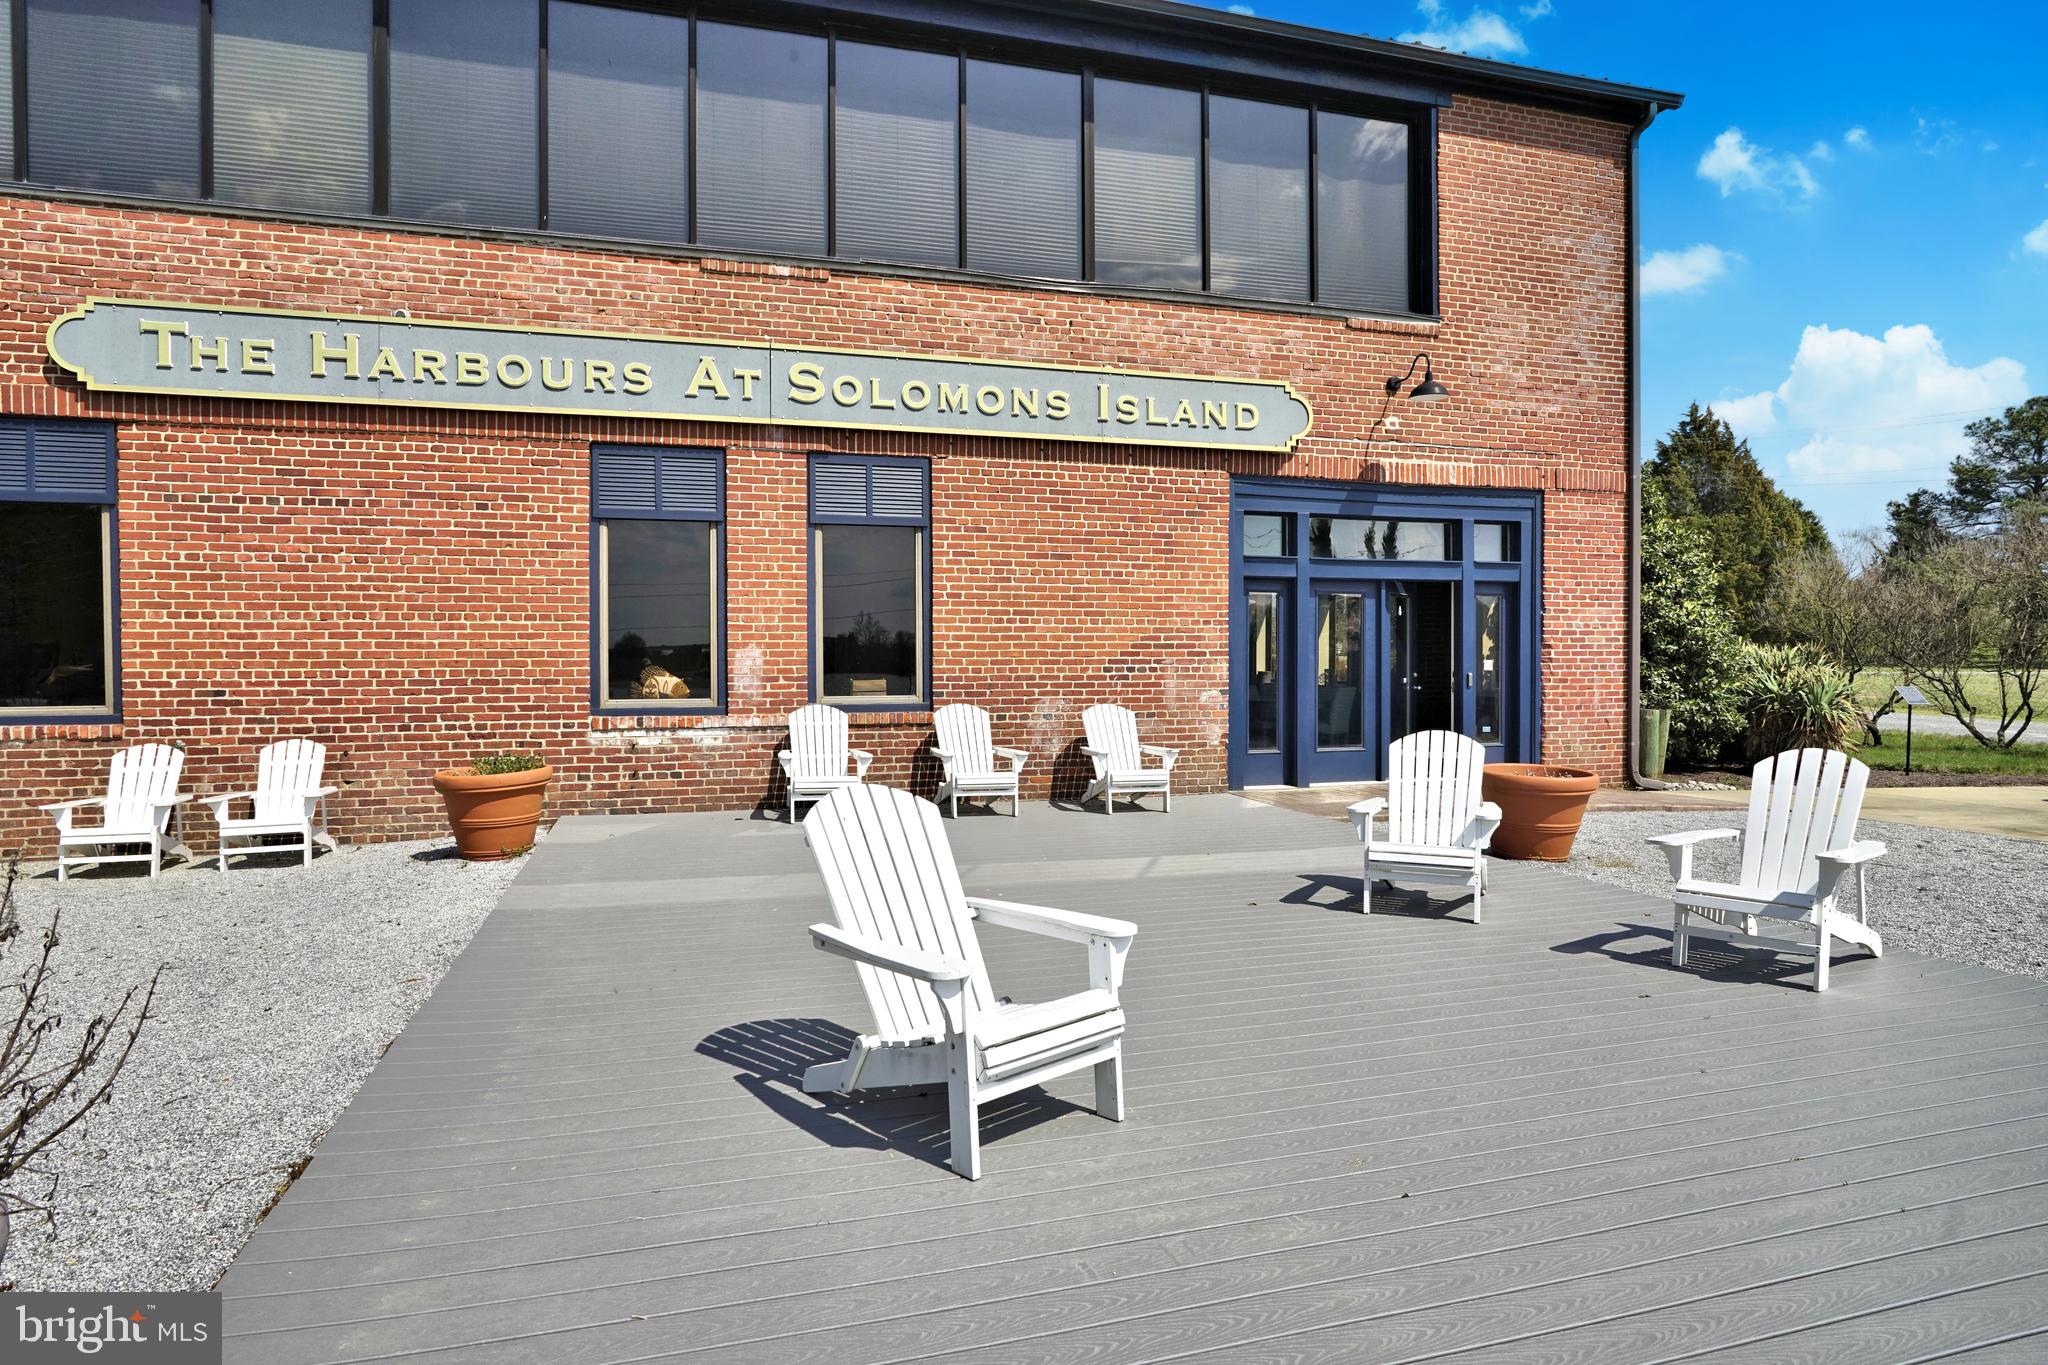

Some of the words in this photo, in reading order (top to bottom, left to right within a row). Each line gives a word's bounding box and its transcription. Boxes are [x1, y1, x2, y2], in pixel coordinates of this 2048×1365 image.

[139, 318, 276, 375] THE
[310, 331, 653, 394] HARBOURS
[685, 355, 762, 400] AT
[787, 362, 1071, 420] SOLOMONS
[1097, 382, 1261, 431] ISLAND
